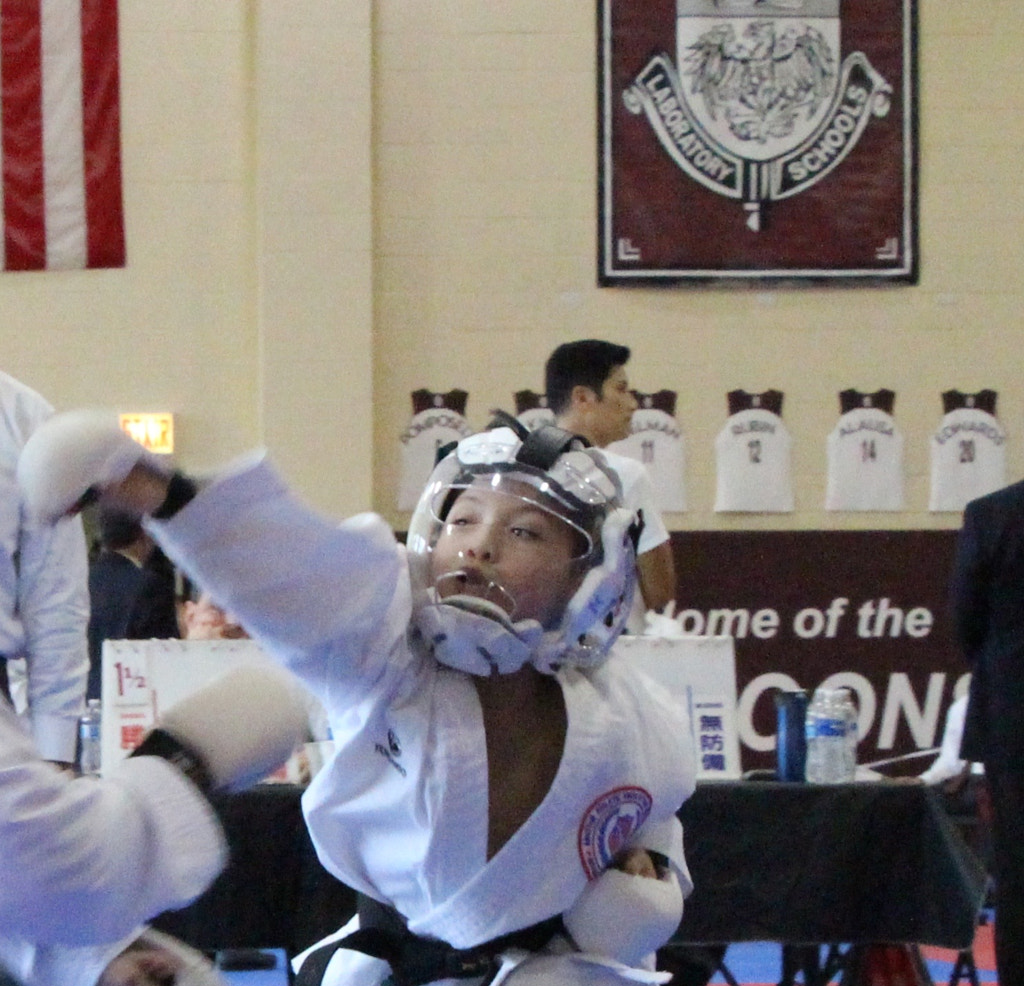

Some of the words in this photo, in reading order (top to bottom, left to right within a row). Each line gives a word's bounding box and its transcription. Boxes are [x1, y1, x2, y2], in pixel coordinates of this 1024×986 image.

[645, 73, 733, 182] LABORATORY
[787, 84, 868, 181] SCHOOLS
[747, 439, 762, 464] 12
[862, 439, 877, 463] 14
[959, 439, 975, 464] 20
[666, 600, 779, 639] ome
[793, 598, 849, 638] of
[857, 598, 932, 638] the
